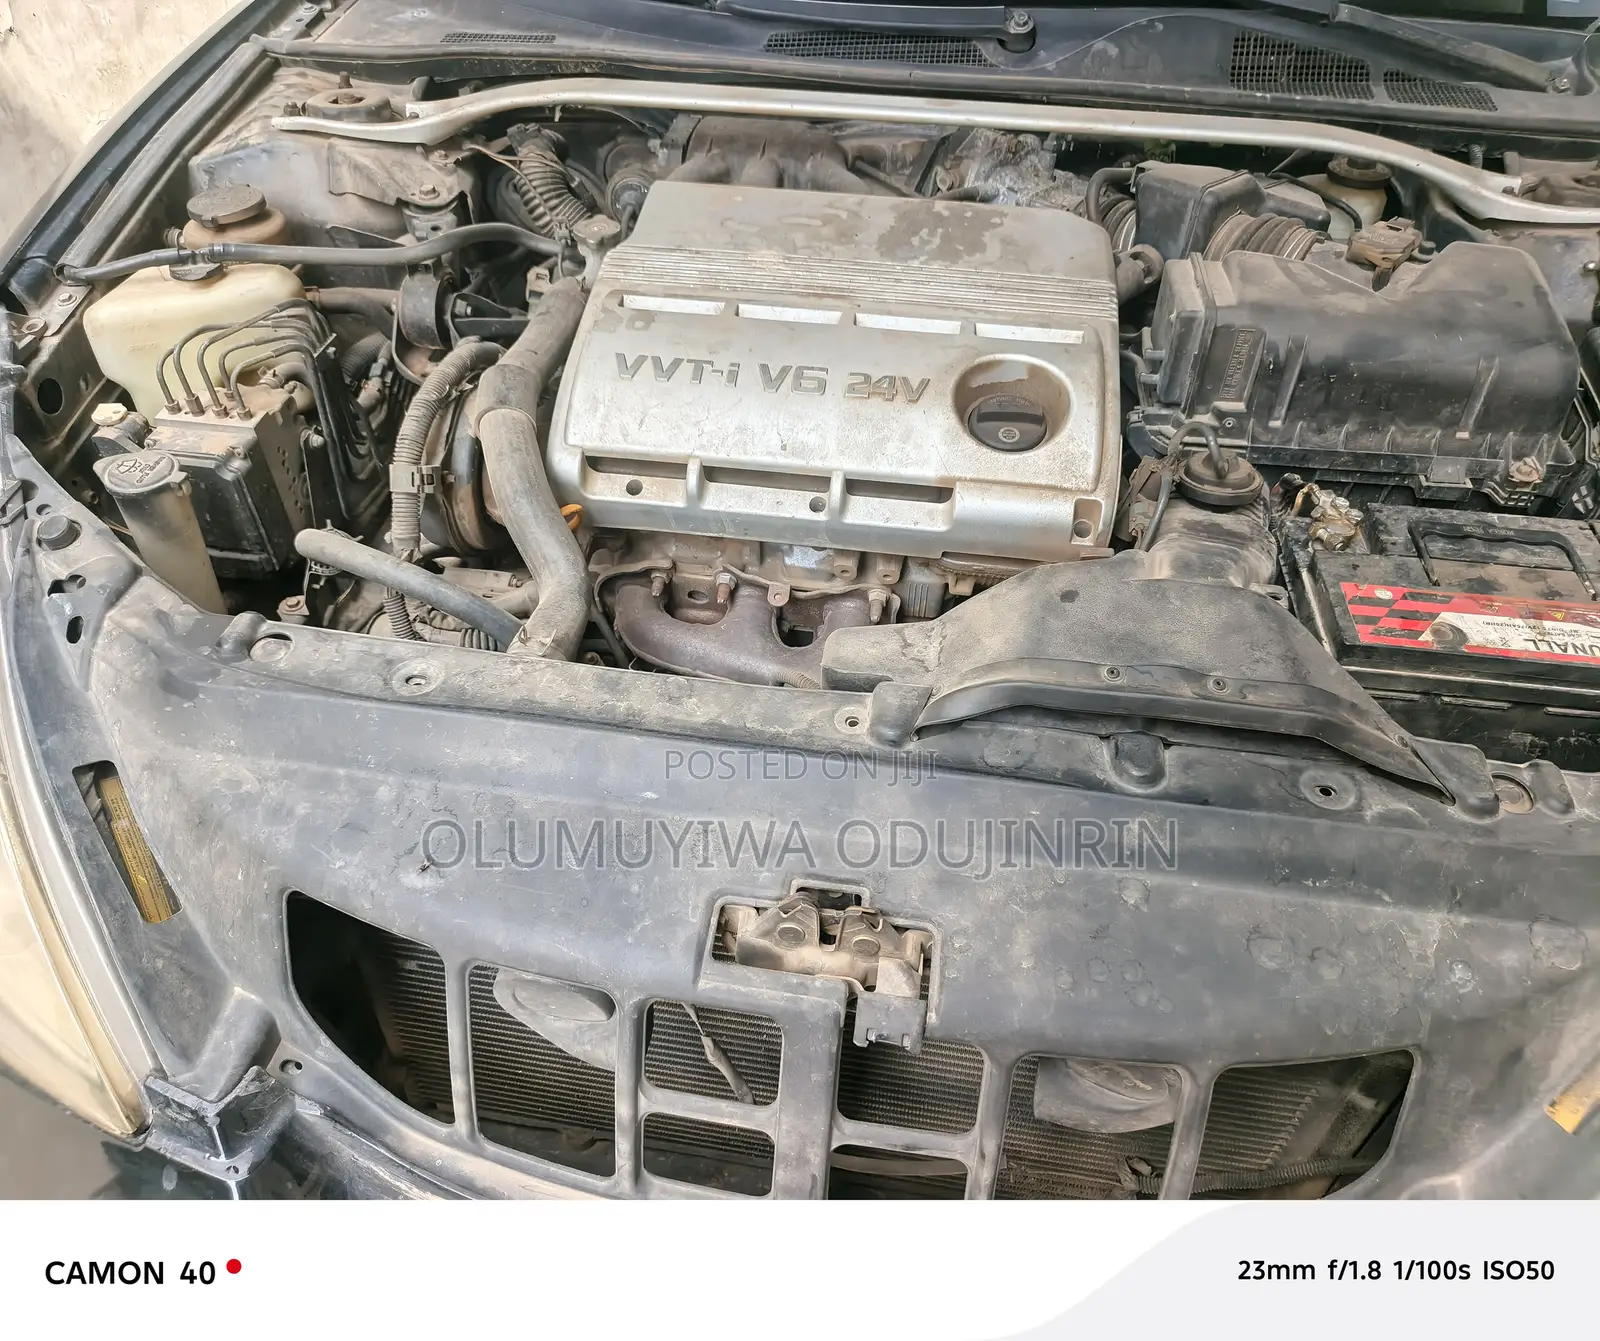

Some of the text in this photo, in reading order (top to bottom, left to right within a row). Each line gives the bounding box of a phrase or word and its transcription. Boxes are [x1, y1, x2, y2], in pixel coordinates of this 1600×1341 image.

[615, 352, 931, 403] VVT-i V6 24V
